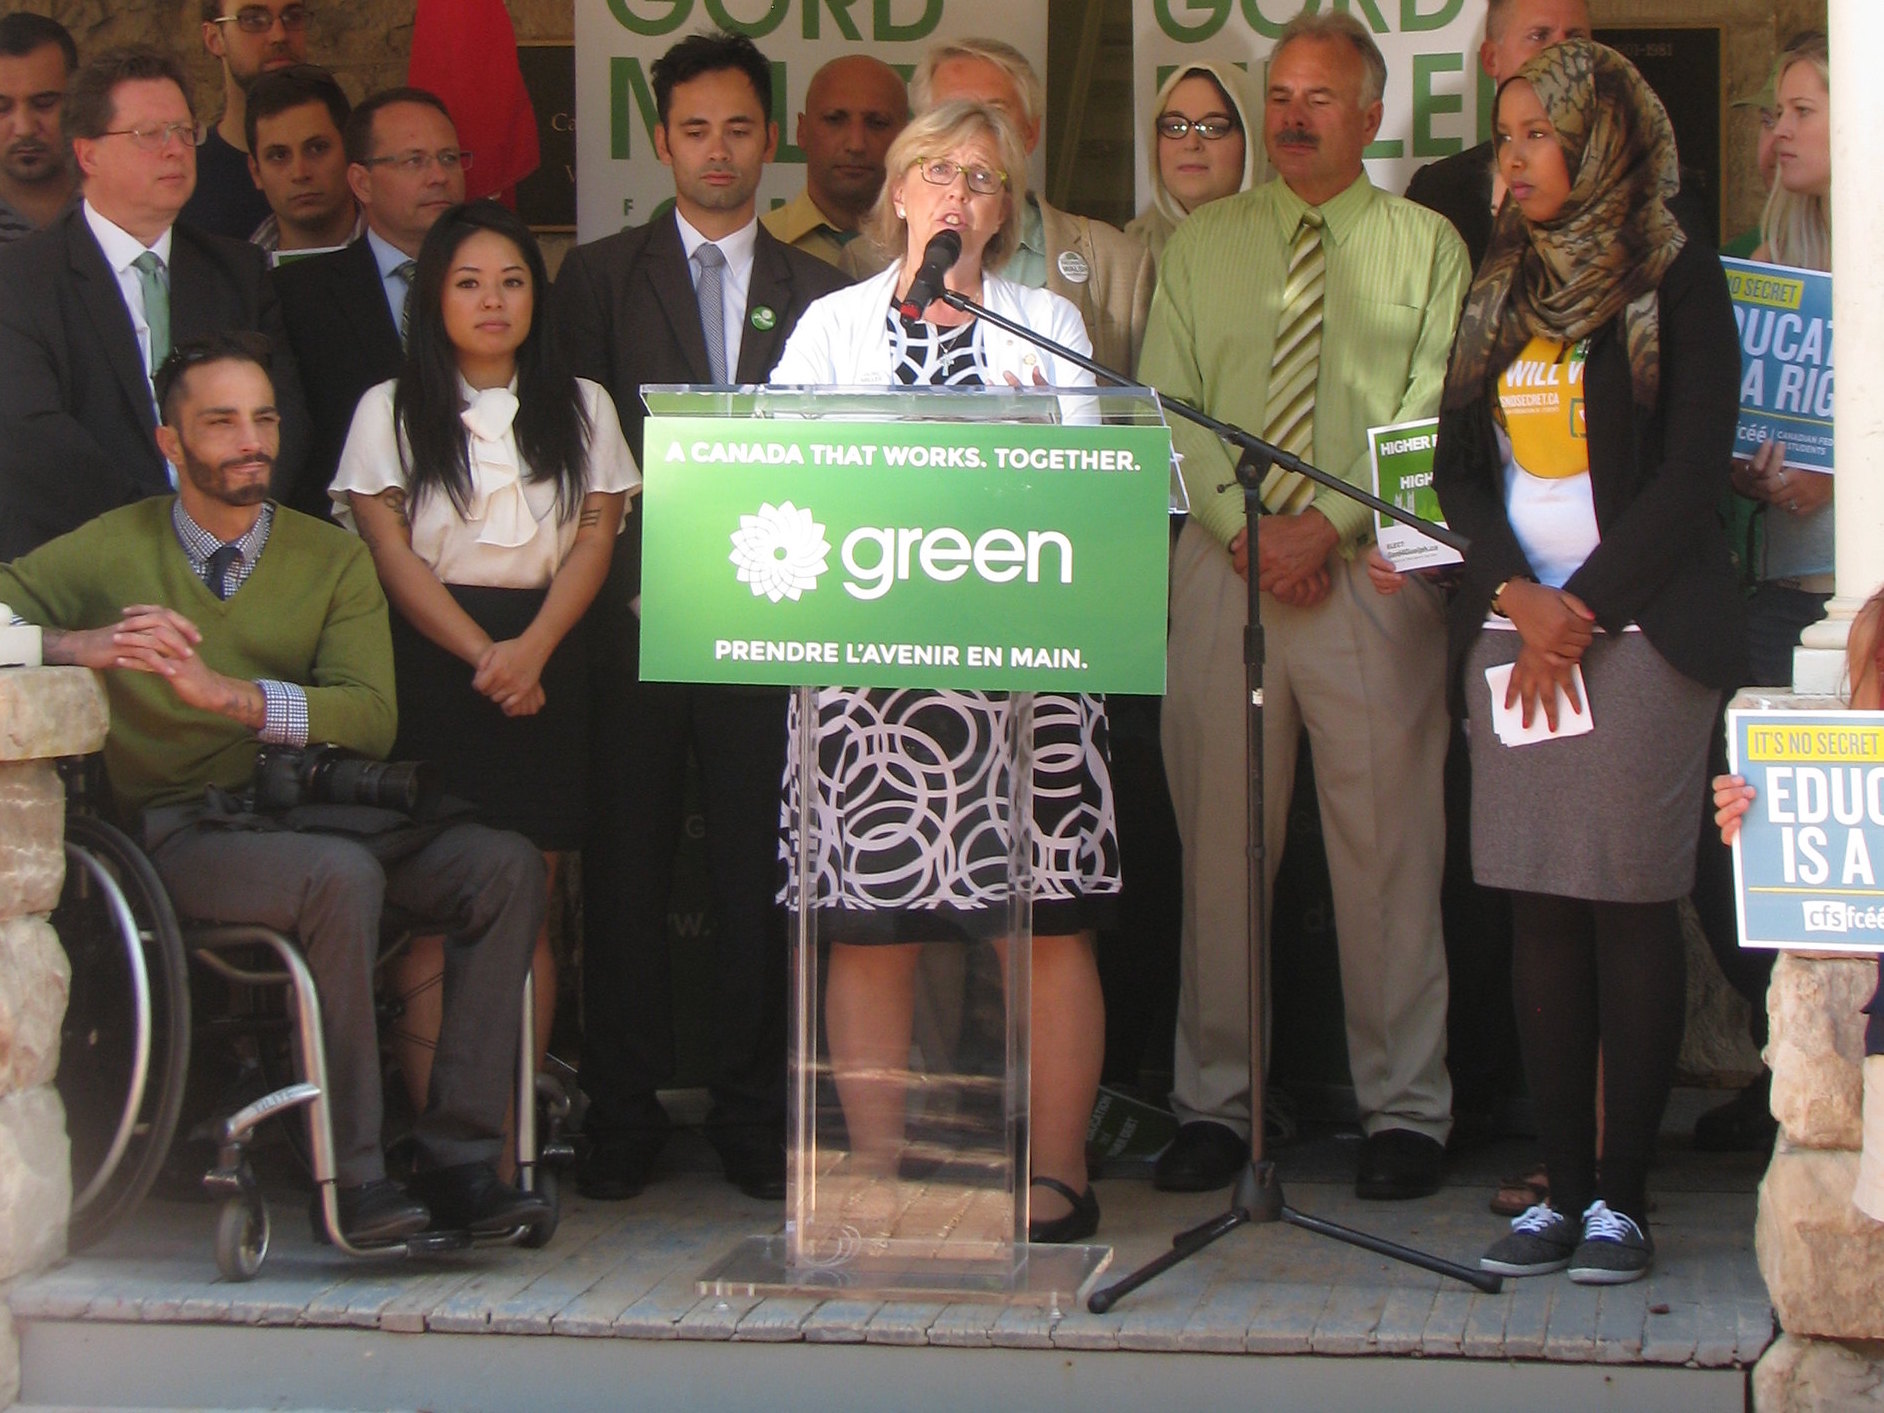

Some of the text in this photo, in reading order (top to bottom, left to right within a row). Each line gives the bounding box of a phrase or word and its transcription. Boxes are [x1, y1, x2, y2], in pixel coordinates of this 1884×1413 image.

[1744, 278, 1798, 303] SECRET
[1505, 359, 1560, 388] WILL
[664, 441, 1141, 471] A CANADA THAT WORKS. TOGETHER.
[1380, 435, 1431, 456] HIGHER
[840, 526, 1073, 600] green
[715, 640, 839, 663] PRENDRE
[967, 646, 1002, 667] EN
[1011, 647, 1088, 669] MAIN.
[1754, 731, 1879, 756] IT'S NO SECRET
[1781, 826, 1876, 885] IS A
